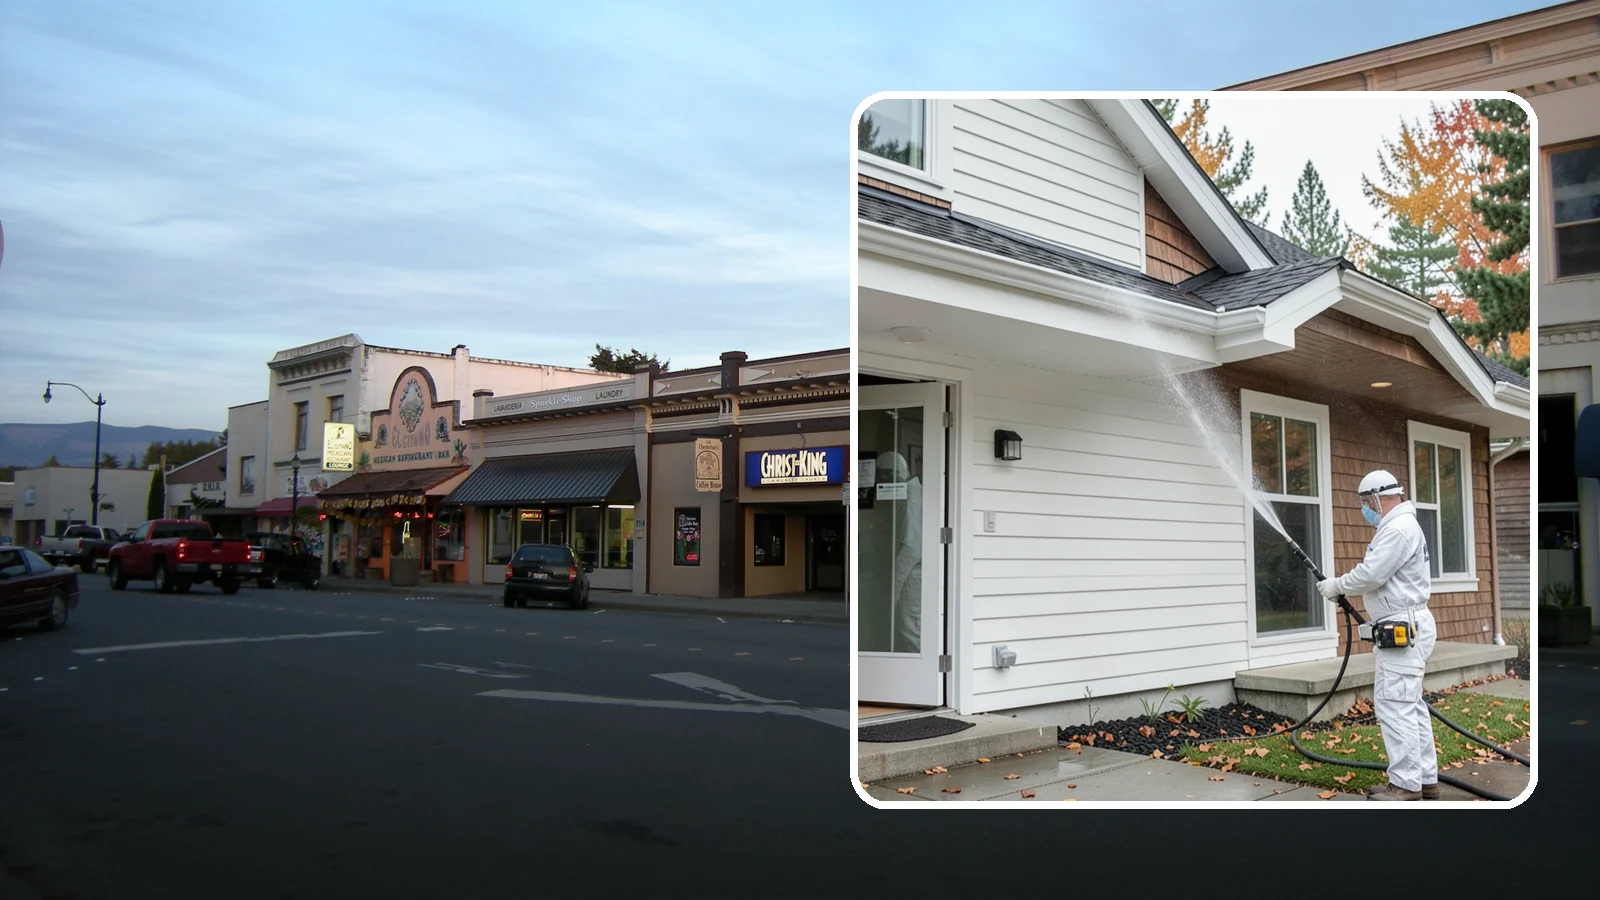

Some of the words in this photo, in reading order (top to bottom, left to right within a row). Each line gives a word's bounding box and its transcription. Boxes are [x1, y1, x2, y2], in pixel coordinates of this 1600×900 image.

[530, 397, 561, 408] Sparkle
[561, 394, 582, 405] Shop
[595, 389, 623, 399] LAUNDRY
[493, 402, 522, 412] LAVANDERIA
[373, 455, 396, 464] MEXICAN
[397, 451, 433, 462] RESTAURANT
[438, 450, 450, 459] BAR
[761, 452, 797, 477] CHRIST
[799, 450, 827, 476] KING
